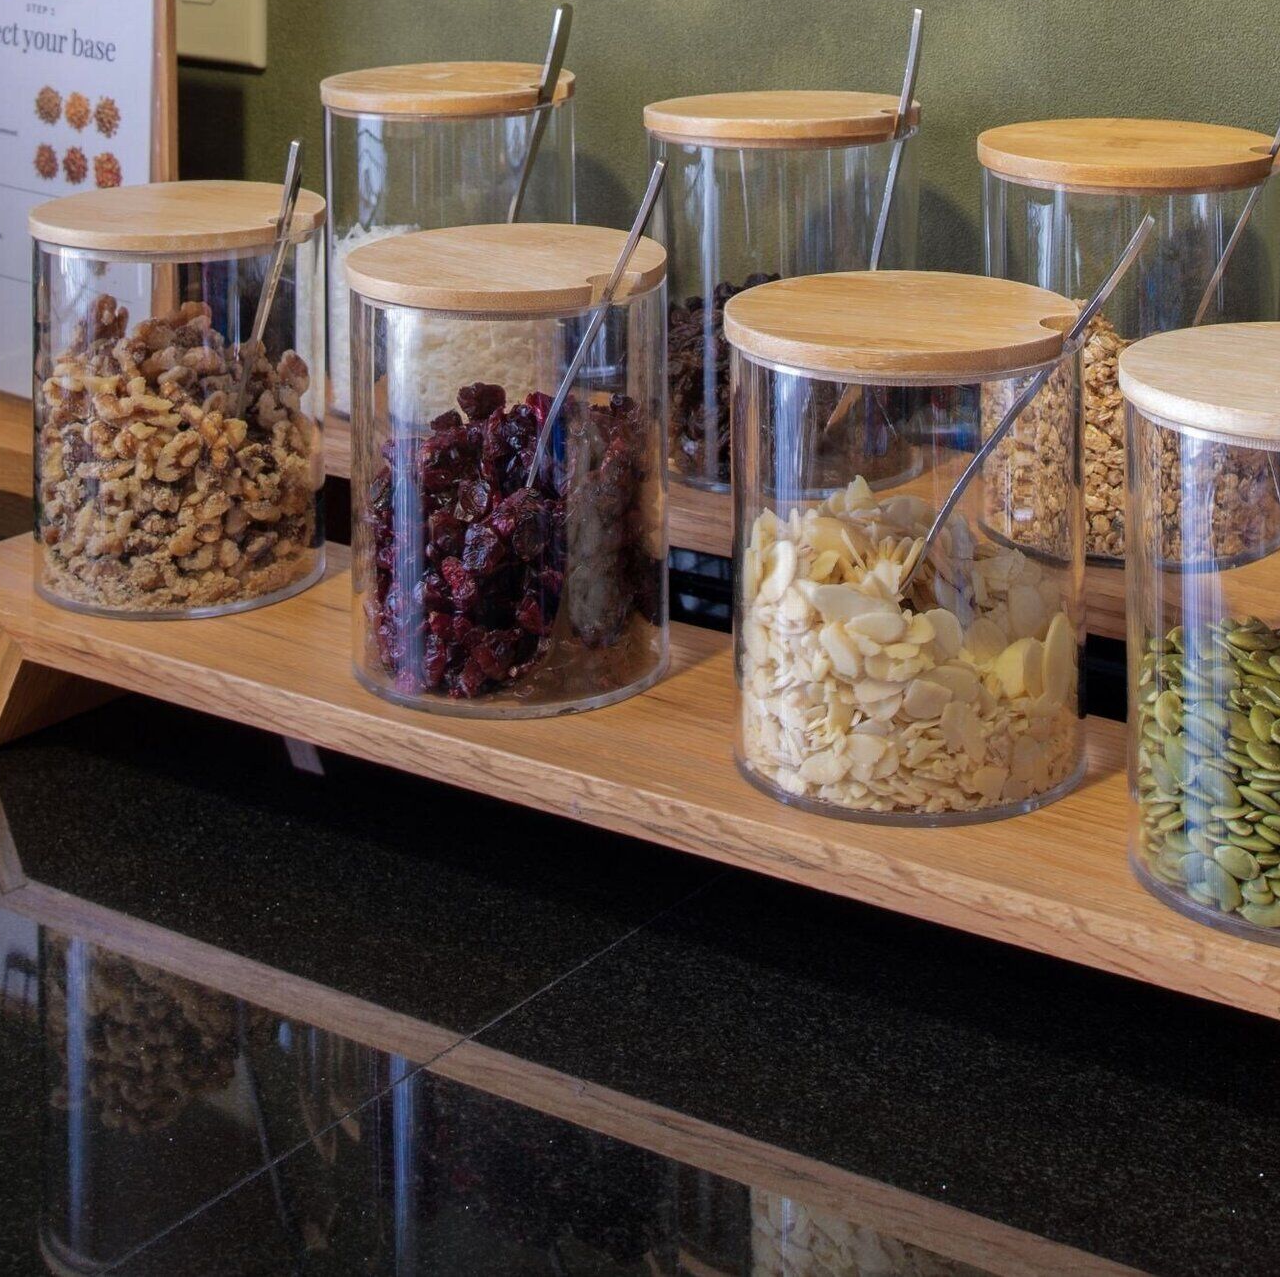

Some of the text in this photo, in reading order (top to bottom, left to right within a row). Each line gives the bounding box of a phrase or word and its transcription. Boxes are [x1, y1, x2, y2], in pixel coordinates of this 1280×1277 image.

[26, 3, 48, 15] STEP
[23, 29, 68, 54] your
[72, 29, 117, 62] base
